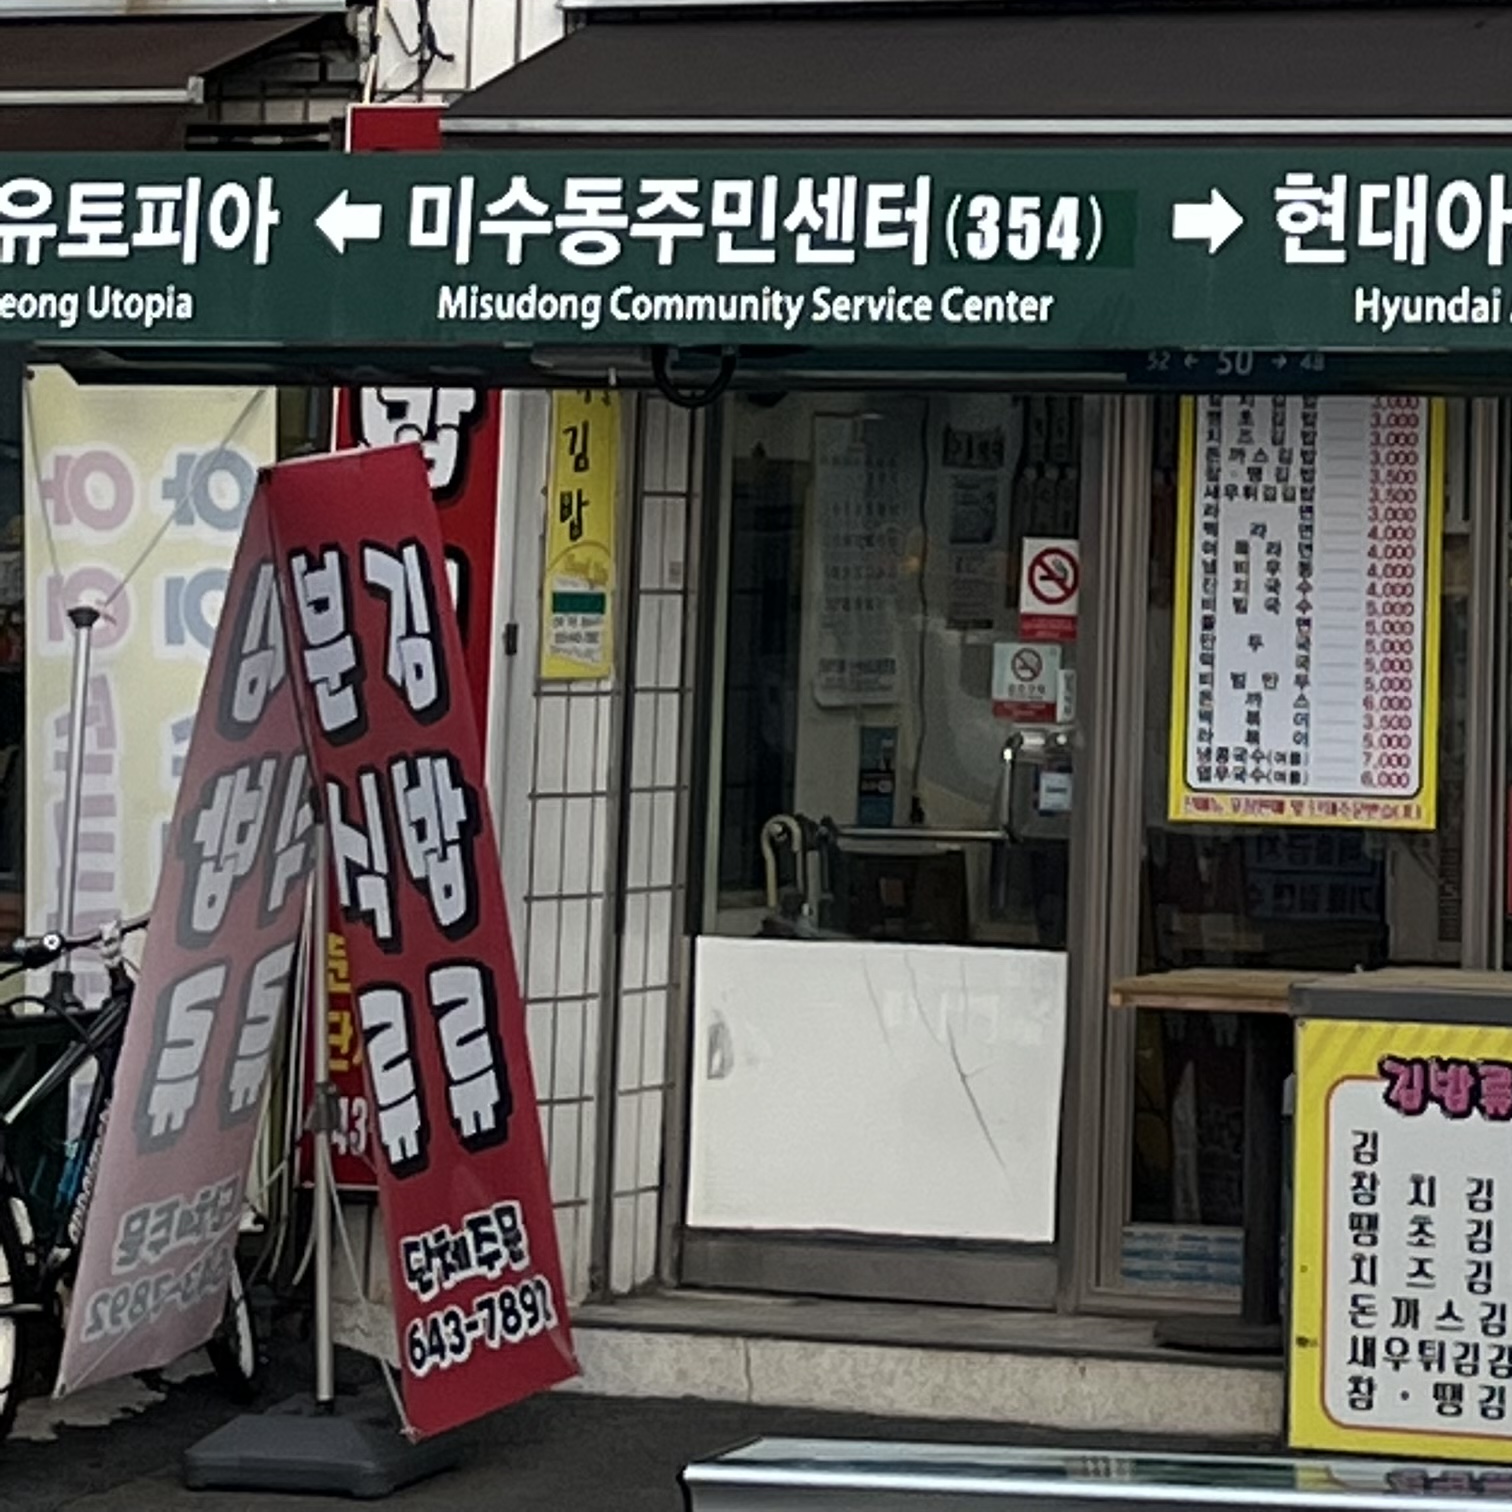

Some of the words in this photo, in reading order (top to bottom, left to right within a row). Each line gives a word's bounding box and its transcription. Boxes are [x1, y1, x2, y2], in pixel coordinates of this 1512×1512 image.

[0, 175, 281, 266] 유토피아
[408, 174, 932, 267] 미수동주민센터
[945, 194, 1103, 262] (354)
[87, 284, 193, 328] Utopia
[436, 283, 602, 330] Misudong
[609, 285, 804, 331] Community
[811, 285, 933, 323] Service
[940, 285, 1054, 323] Center
[1354, 285, 1502, 333] Hyundai
[559, 419, 591, 542] 김밥
